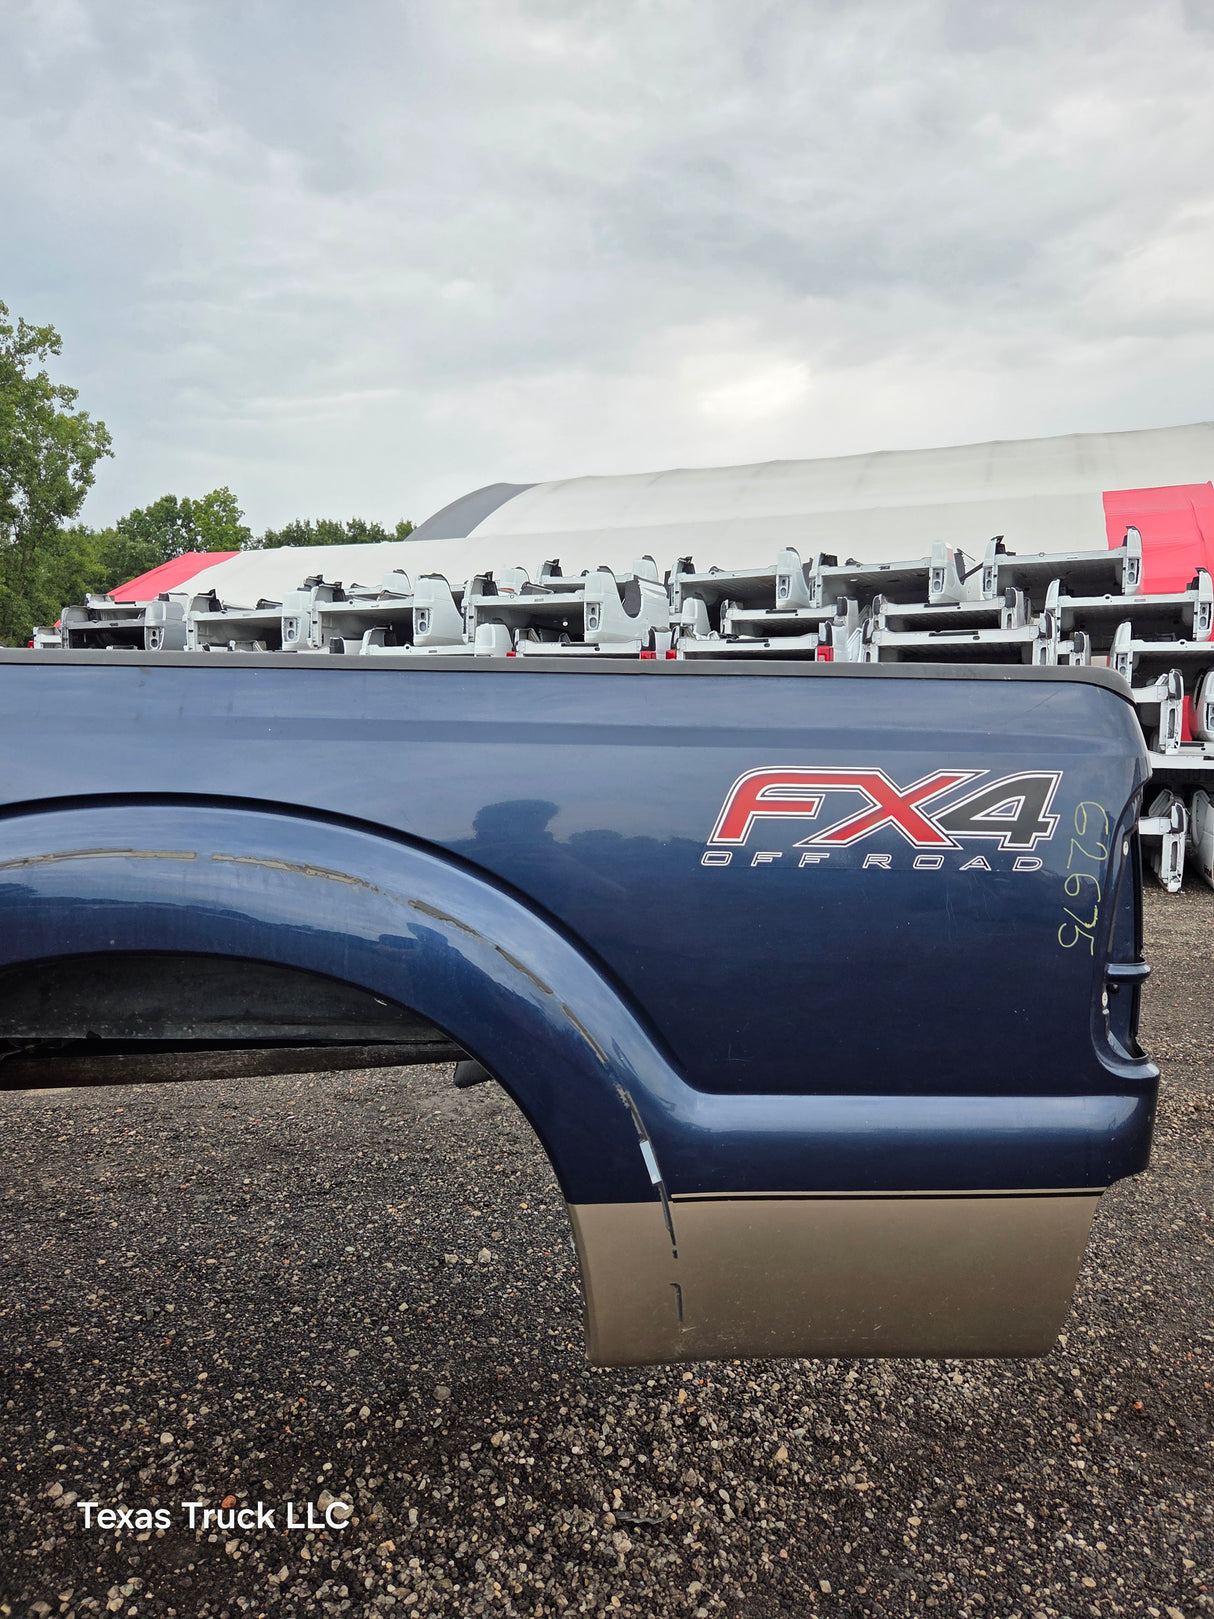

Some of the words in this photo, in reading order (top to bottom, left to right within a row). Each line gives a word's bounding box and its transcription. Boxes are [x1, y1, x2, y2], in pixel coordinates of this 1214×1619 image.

[707, 766, 1063, 851] FX4
[701, 851, 830, 868] OFF
[862, 853, 1044, 871] ROAD
[1057, 801, 1109, 956] 62675
